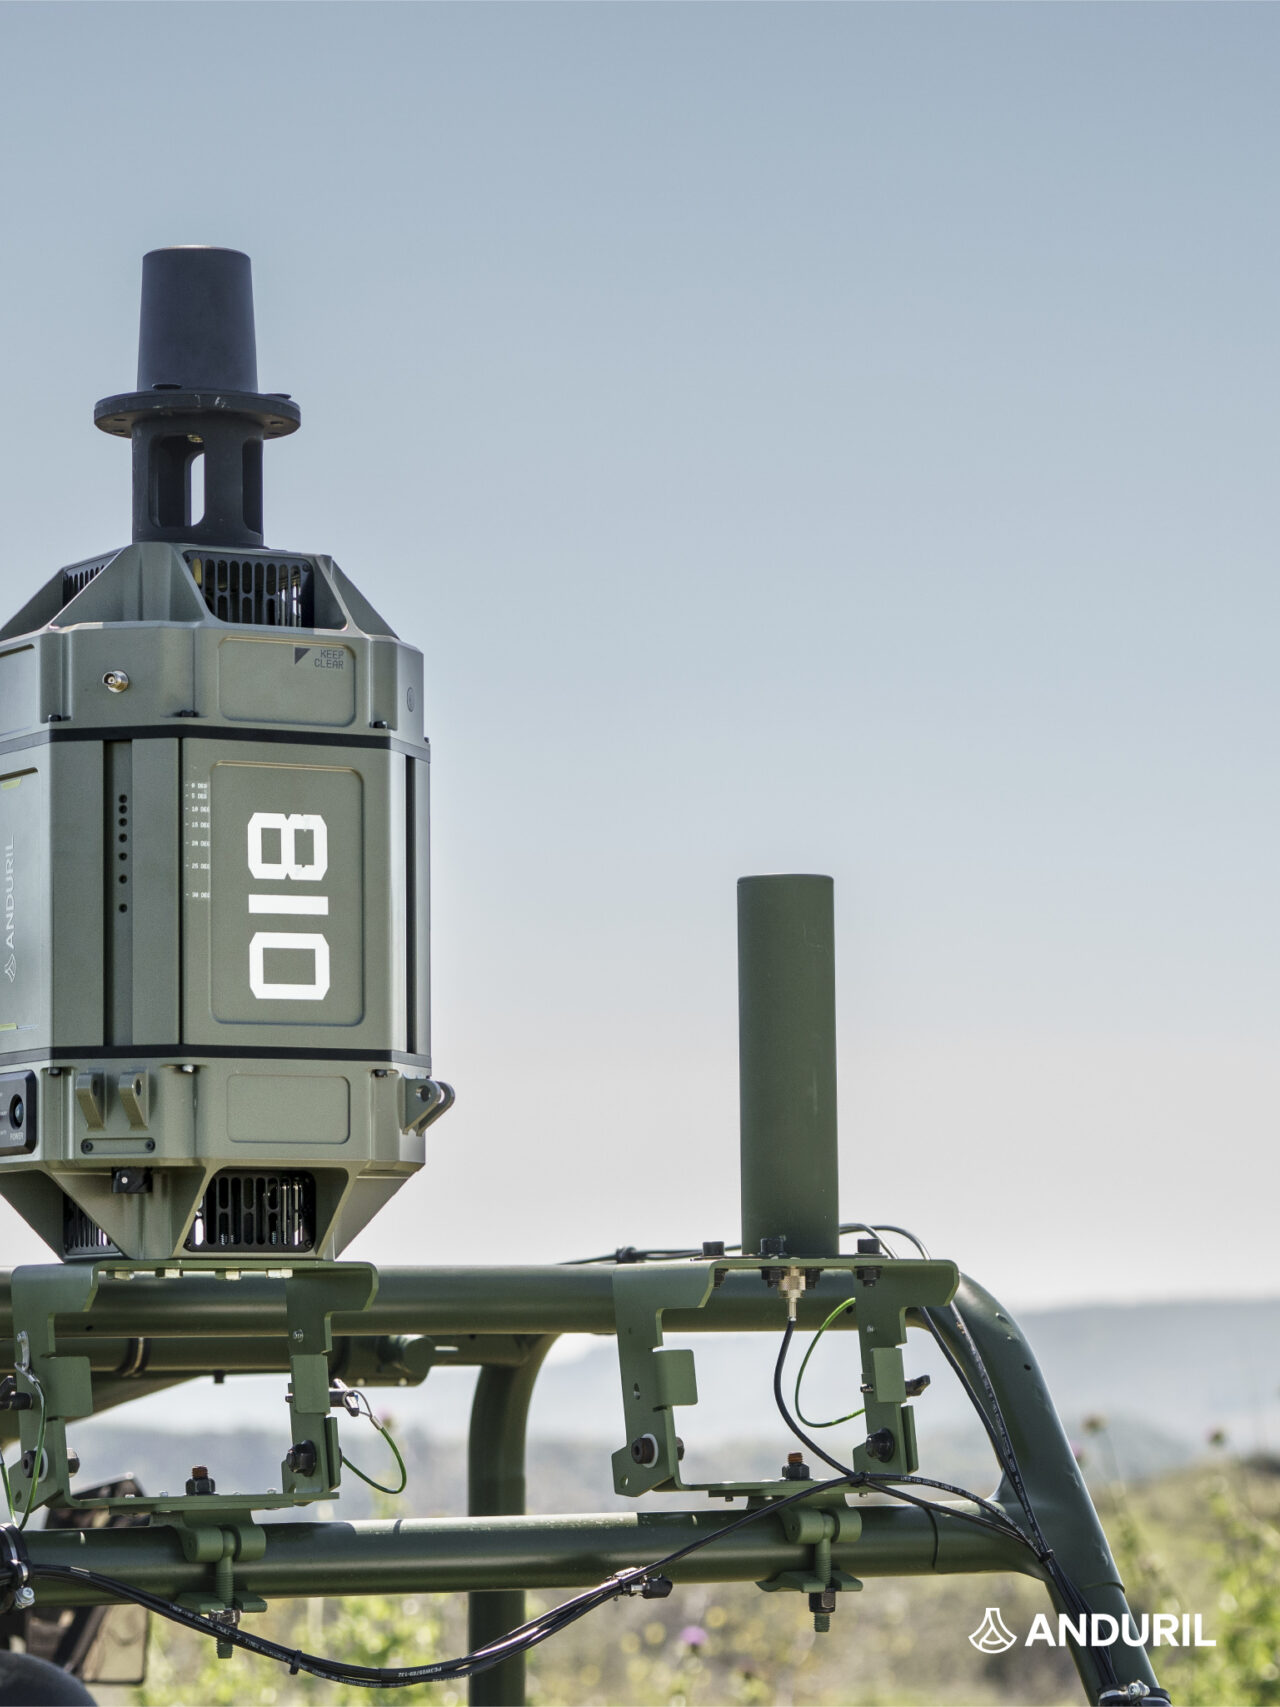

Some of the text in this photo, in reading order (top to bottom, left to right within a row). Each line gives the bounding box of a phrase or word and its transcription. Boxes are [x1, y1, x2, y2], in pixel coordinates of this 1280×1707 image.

[320, 649, 345, 660] KEEP
[314, 658, 344, 670] CLEAR
[5, 833, 15, 949] ANDURIL
[248, 813, 330, 1000] 018
[10, 1132, 24, 1141] POWER
